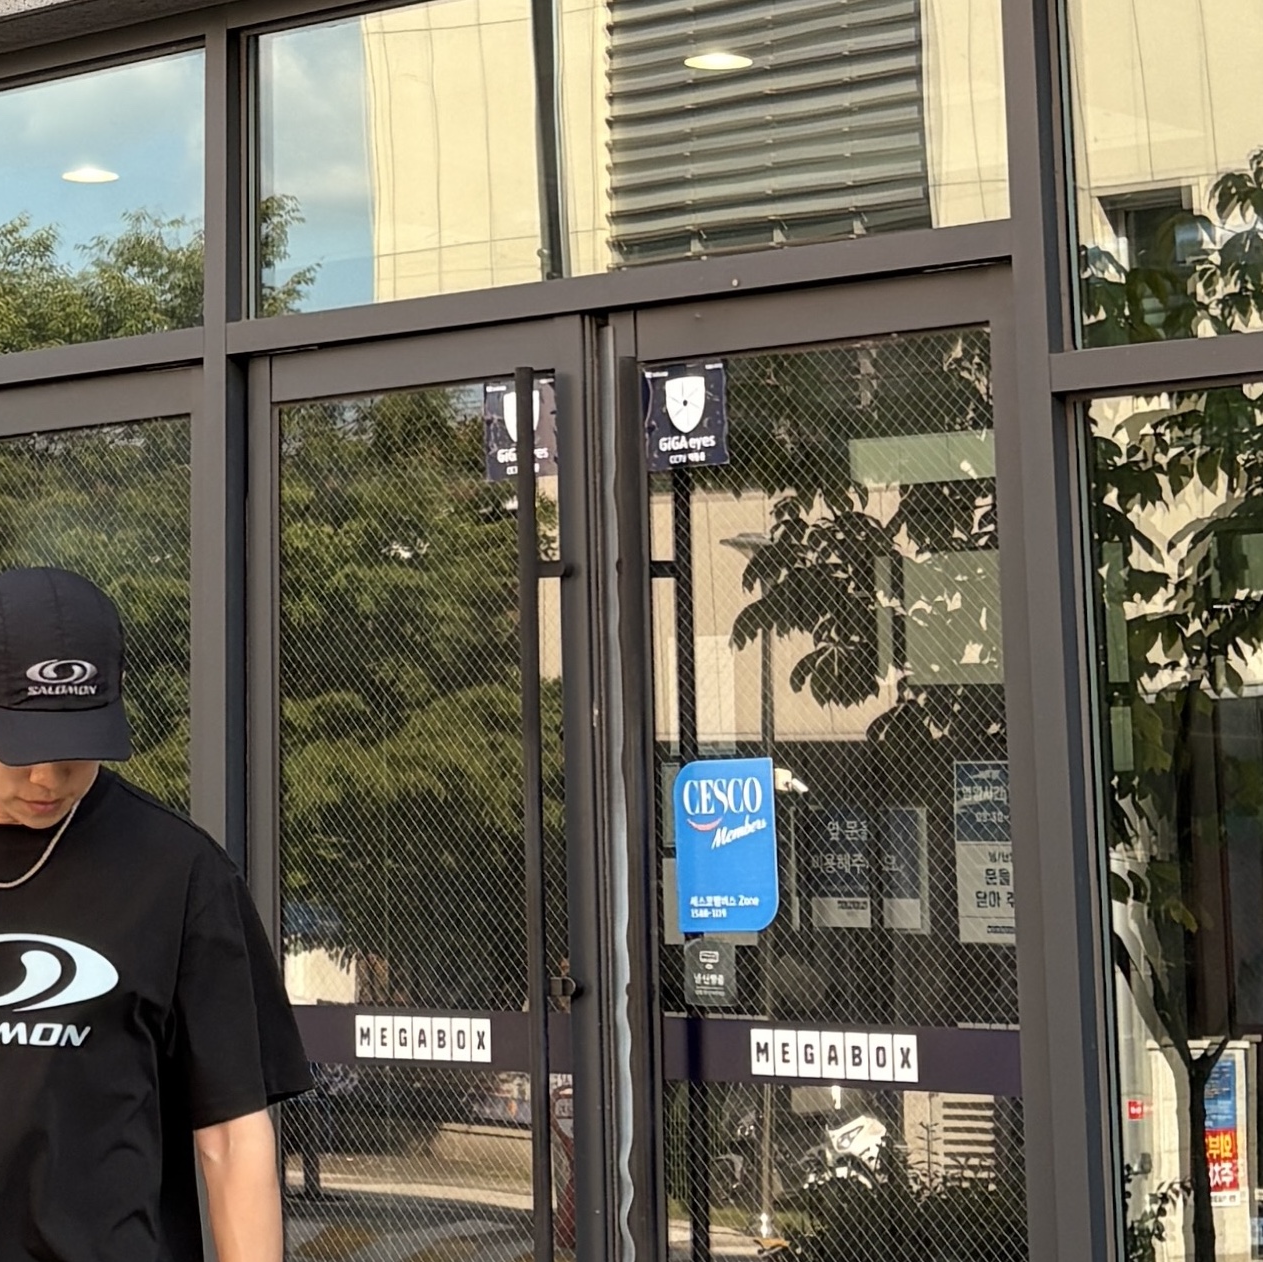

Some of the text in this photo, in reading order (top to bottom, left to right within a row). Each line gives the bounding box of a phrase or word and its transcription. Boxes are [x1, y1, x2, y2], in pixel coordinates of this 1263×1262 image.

[28, 685, 97, 696] SALOMON
[683, 777, 763, 816] CESCO
[711, 814, 767, 850] Members
[827, 821, 840, 840] 옆
[976, 890, 1000, 909] 닫아
[359, 1026, 486, 1051] MEGABOX
[756, 1041, 911, 1070] MEGABOX
